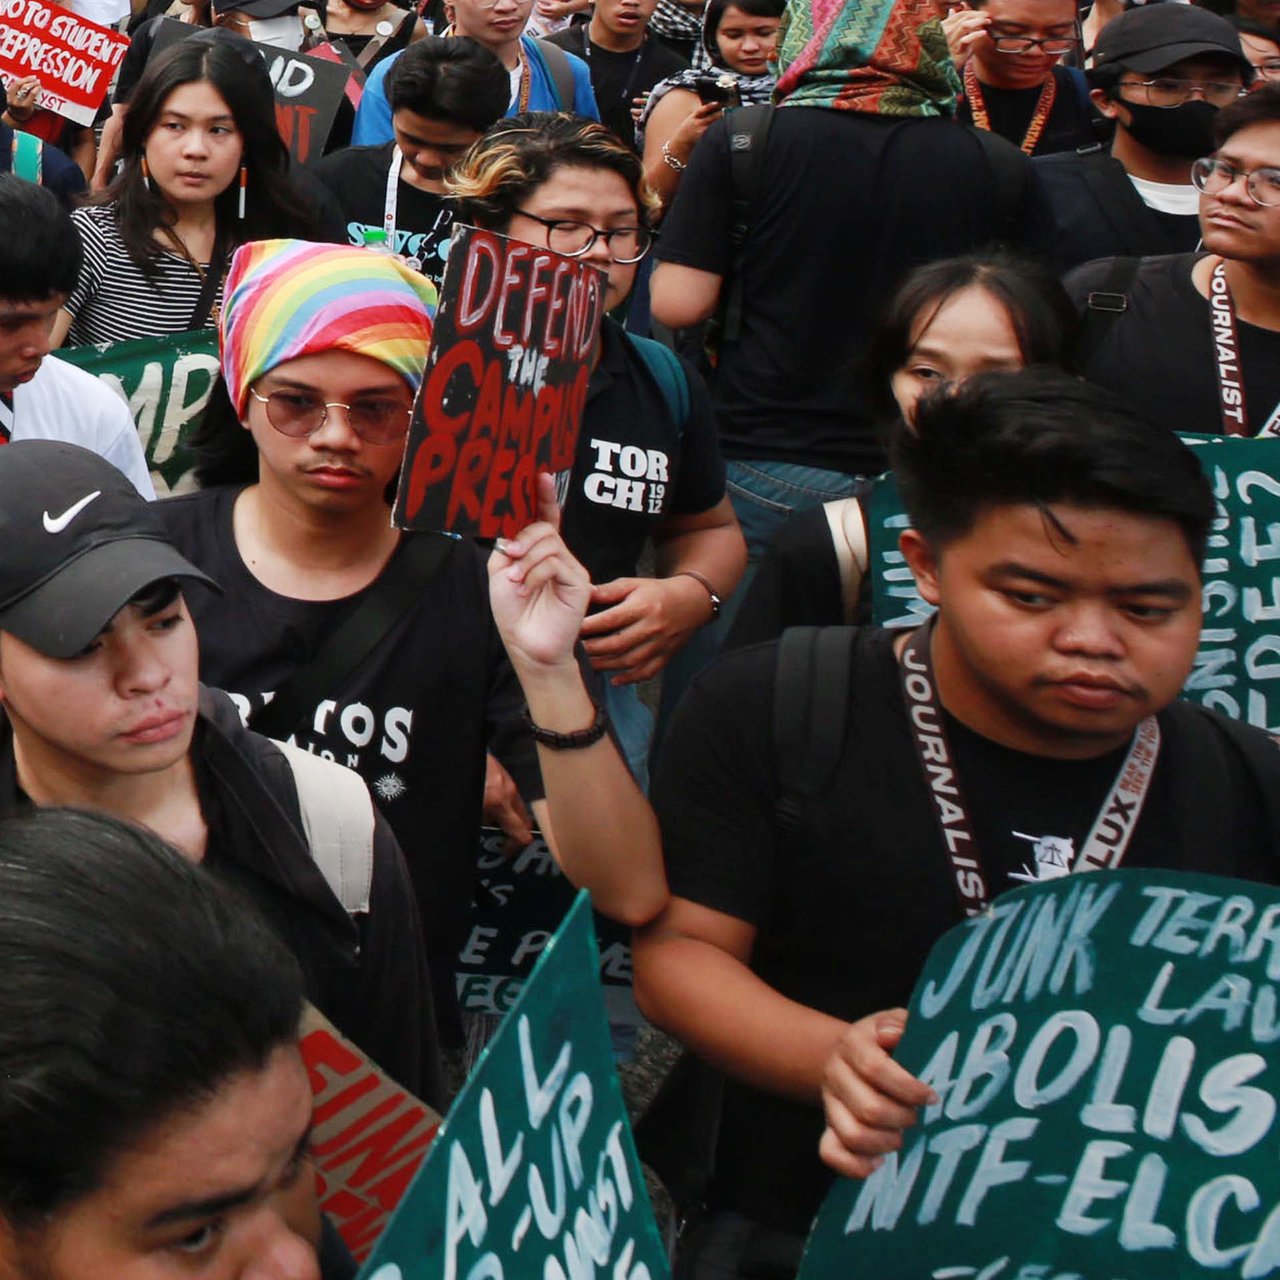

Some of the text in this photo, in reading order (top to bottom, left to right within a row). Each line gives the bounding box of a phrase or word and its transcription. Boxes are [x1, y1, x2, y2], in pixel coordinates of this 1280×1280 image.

[22, 0, 52, 29] TO
[48, 15, 129, 66] STUDENT
[456, 238, 606, 352] DEFEND
[507, 346, 551, 393] THE
[1210, 262, 1244, 425] JOURNALIST
[423, 339, 587, 468] CAMPUS
[590, 437, 669, 483] TOR
[584, 473, 666, 514] CH 19
[647, 497, 664, 515] 12
[919, 881, 1124, 1019] JUNK
